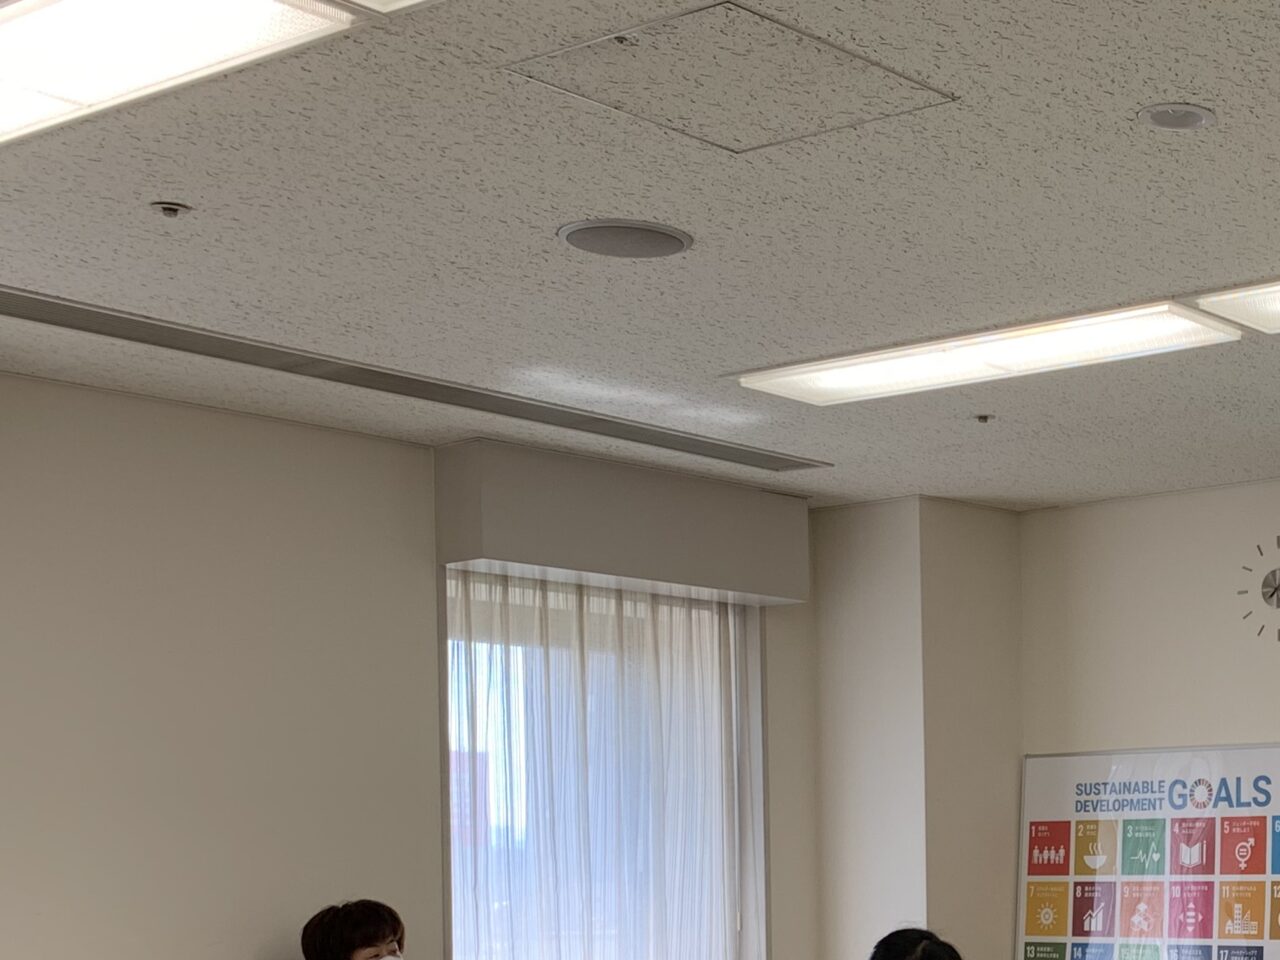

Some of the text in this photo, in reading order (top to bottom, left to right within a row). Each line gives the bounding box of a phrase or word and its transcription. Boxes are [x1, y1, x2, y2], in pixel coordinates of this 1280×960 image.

[1075, 780, 1166, 797] SUSTAINABLE
[1168, 775, 1272, 811] GOALS
[1074, 798, 1165, 813] DEVELOPMENT
[1078, 824, 1085, 837] 2
[1127, 825, 1134, 838] 3
[1173, 822, 1180, 834] 4
[1223, 821, 1230, 834] 5
[1274, 820, 1280, 833] 6
[1029, 886, 1035, 898] 7
[1075, 885, 1082, 898] 8
[1123, 885, 1130, 898] 9
[1171, 886, 1181, 899] 10
[1222, 886, 1231, 899] 11
[1026, 945, 1036, 959] 13
[1073, 947, 1083, 960] 14
